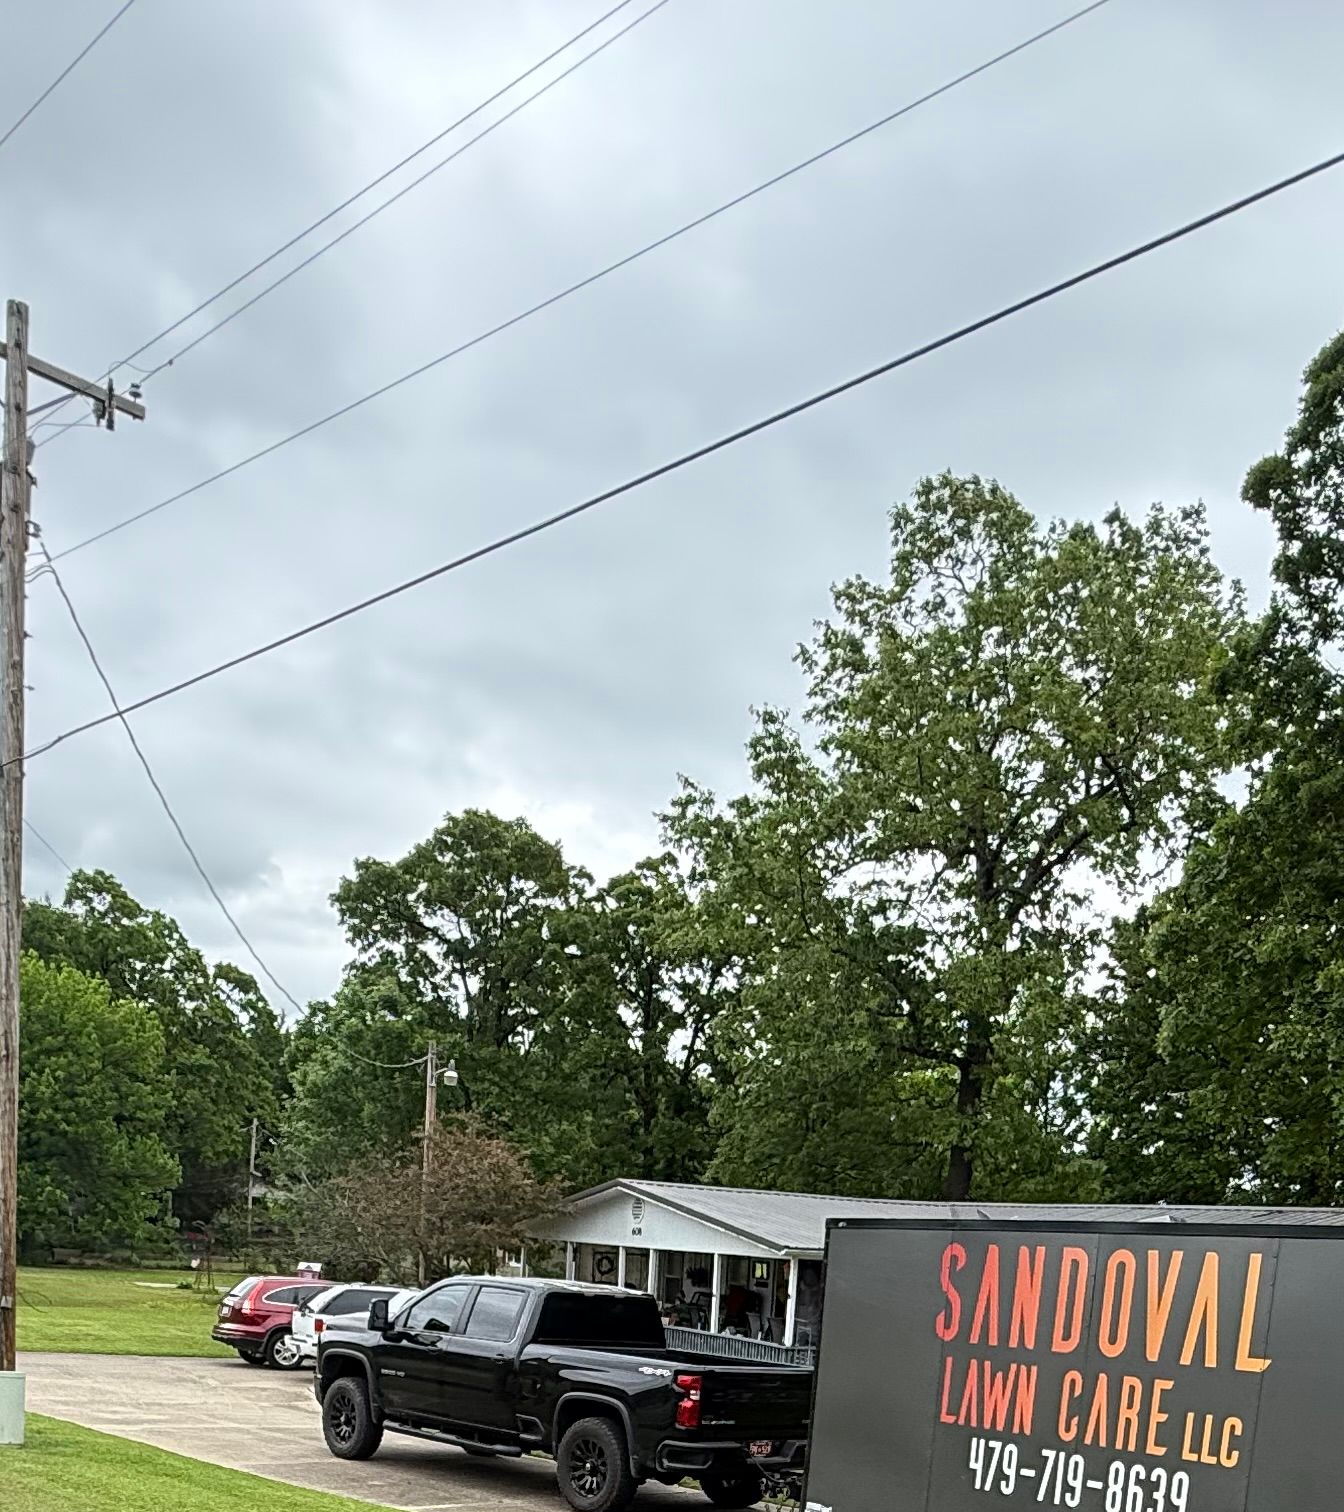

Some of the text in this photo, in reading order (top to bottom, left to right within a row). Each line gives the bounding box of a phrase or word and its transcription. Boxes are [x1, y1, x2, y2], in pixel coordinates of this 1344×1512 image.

[935, 1242, 1272, 1372] SANDOVAL
[940, 1356, 1243, 1467] LAWN CARE LLC
